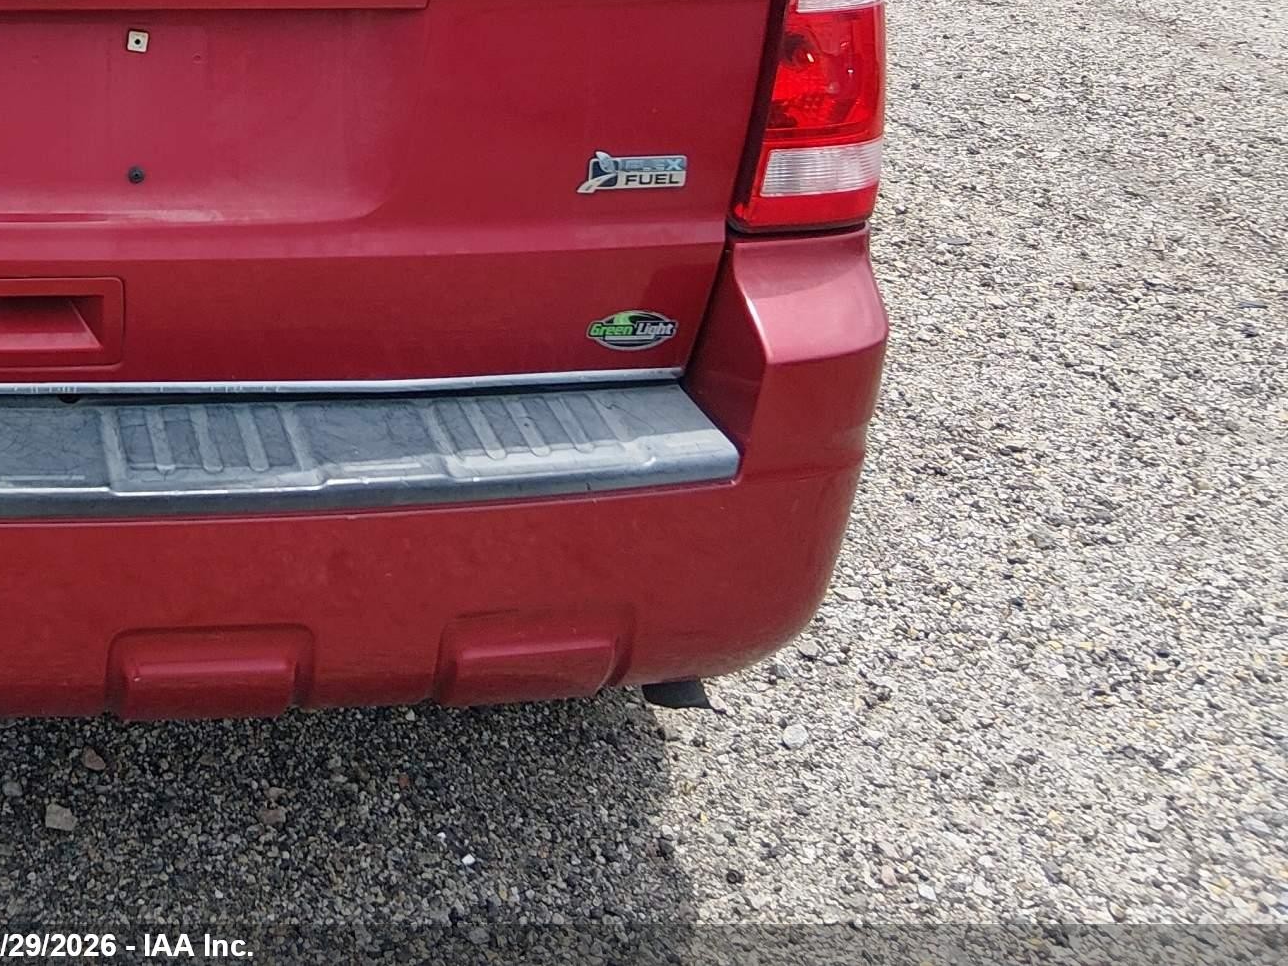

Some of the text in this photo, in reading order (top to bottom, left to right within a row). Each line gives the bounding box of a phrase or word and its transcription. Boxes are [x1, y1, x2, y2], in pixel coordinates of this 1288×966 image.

[625, 173, 680, 186] FUEL
[589, 322, 674, 336] Green Light
